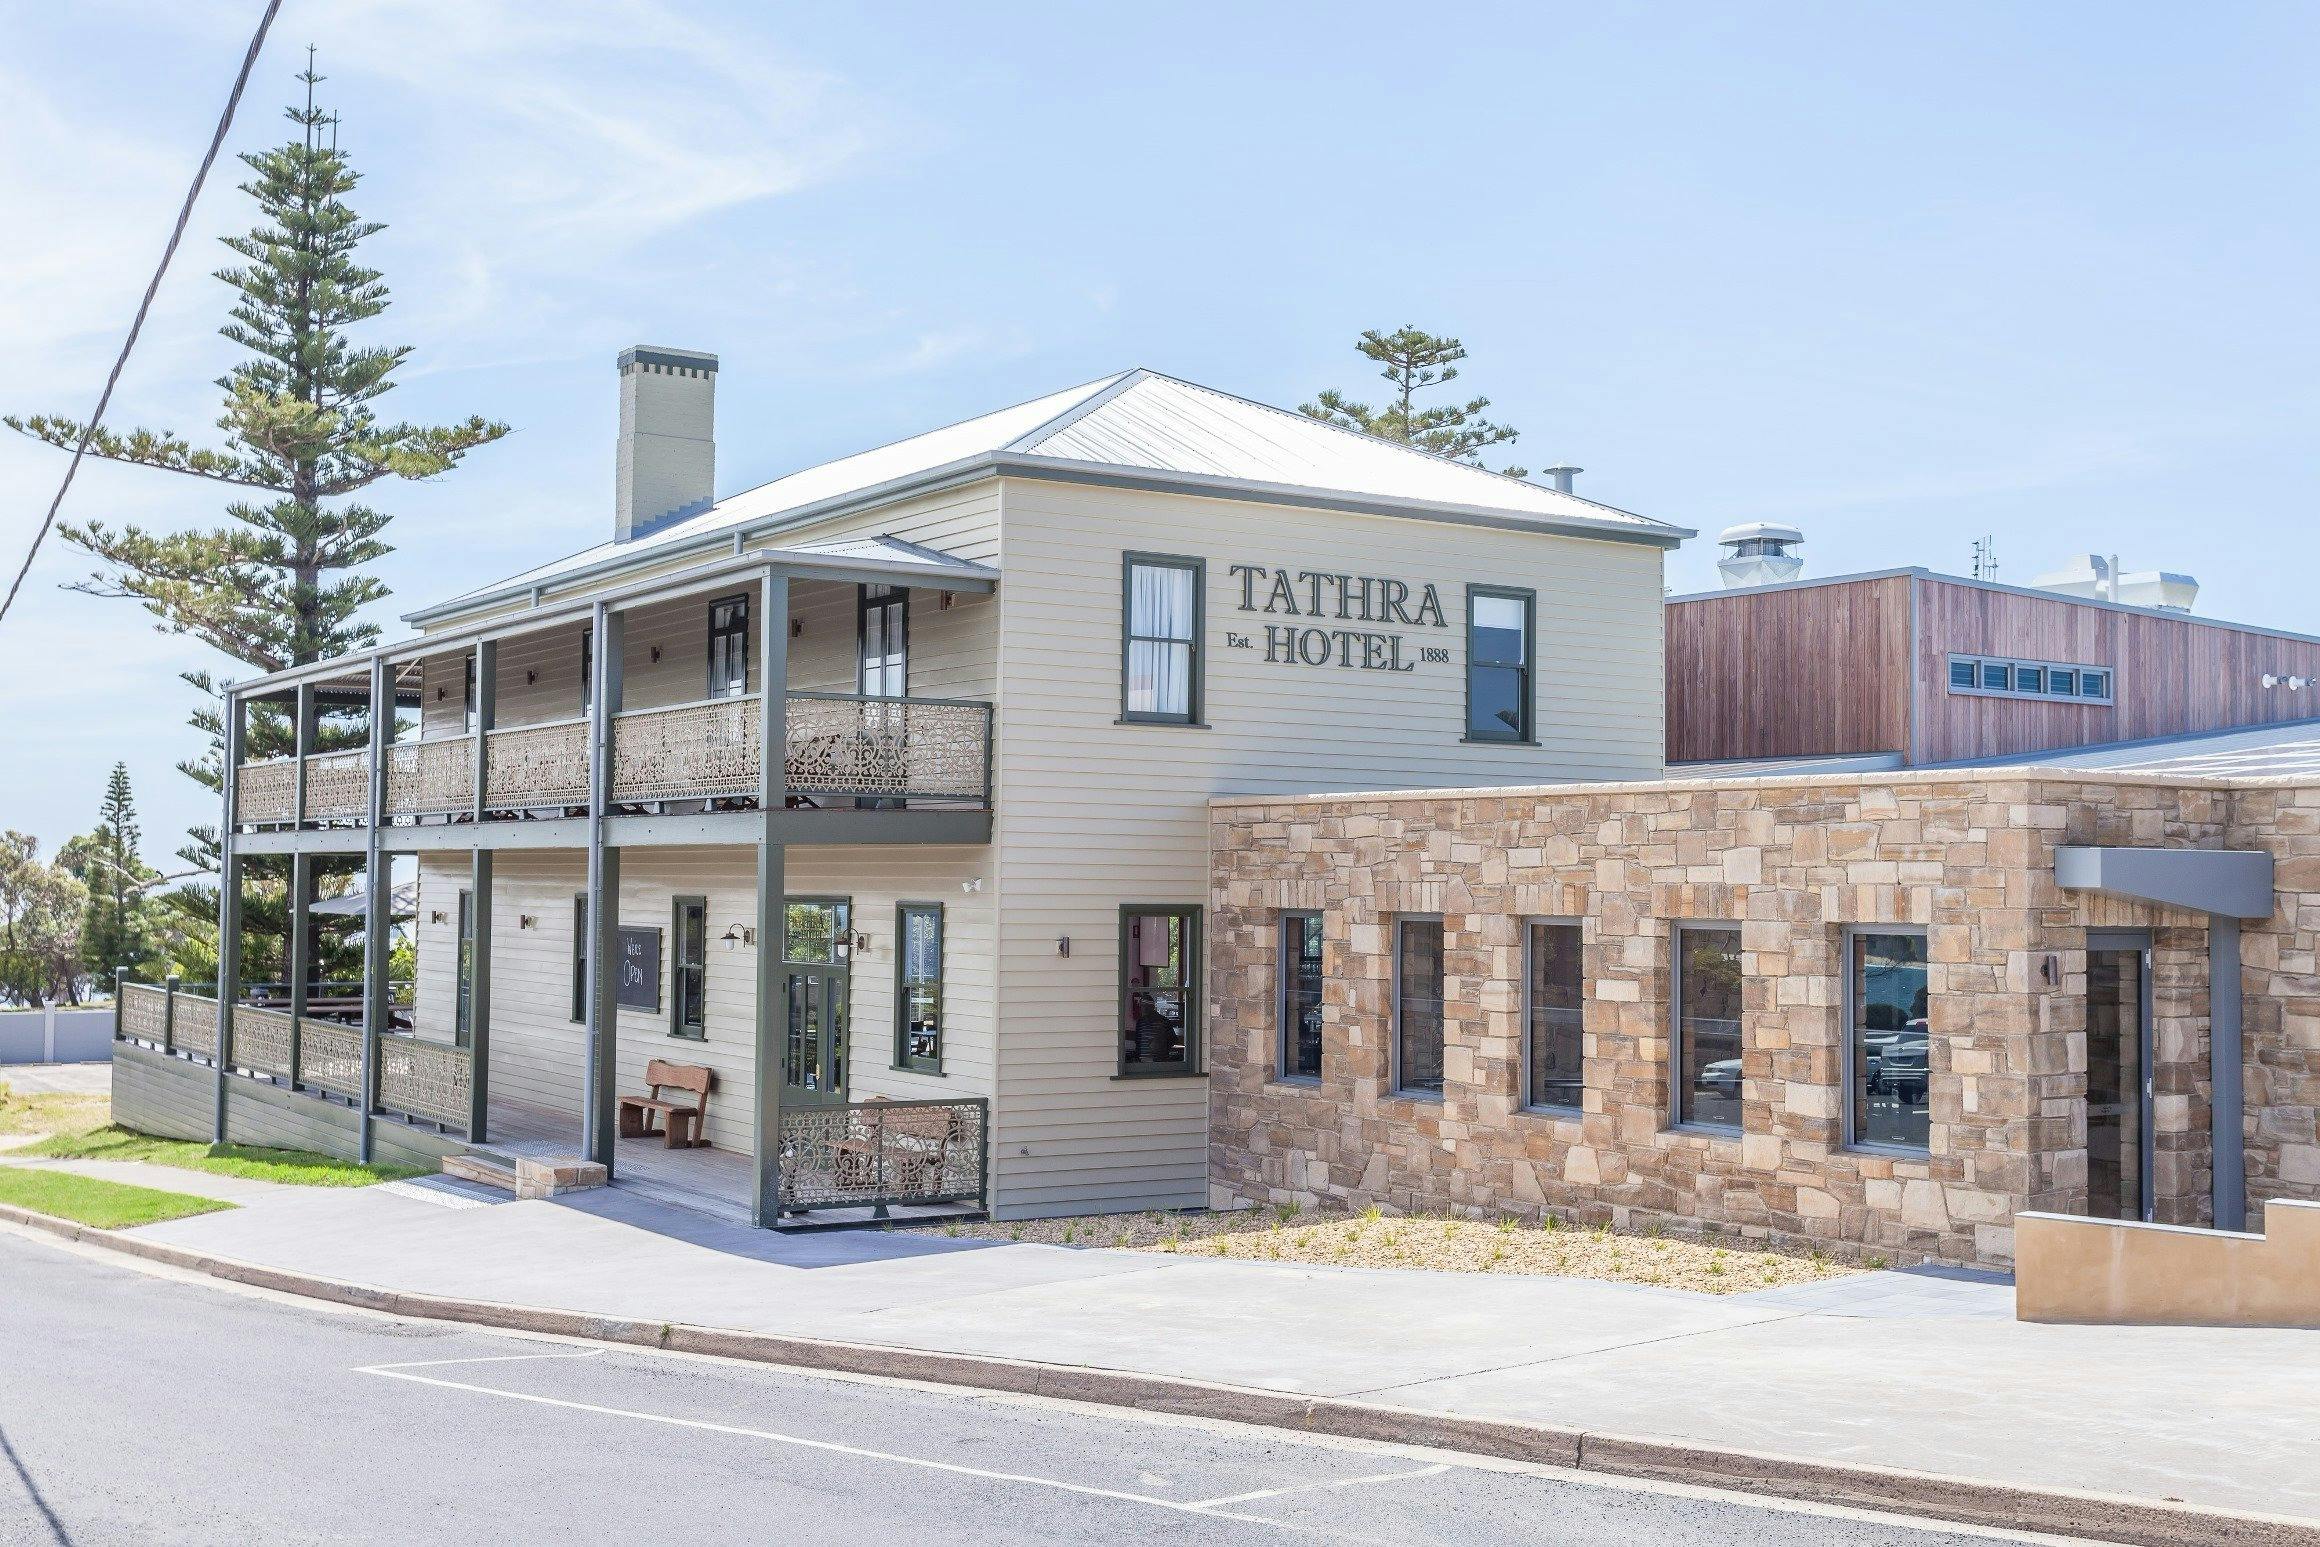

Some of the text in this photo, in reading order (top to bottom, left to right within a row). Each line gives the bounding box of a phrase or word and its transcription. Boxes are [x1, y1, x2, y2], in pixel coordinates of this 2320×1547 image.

[1229, 565, 1448, 627] TATHRA
[1226, 625, 1450, 671] Est. HOTEL 1888
